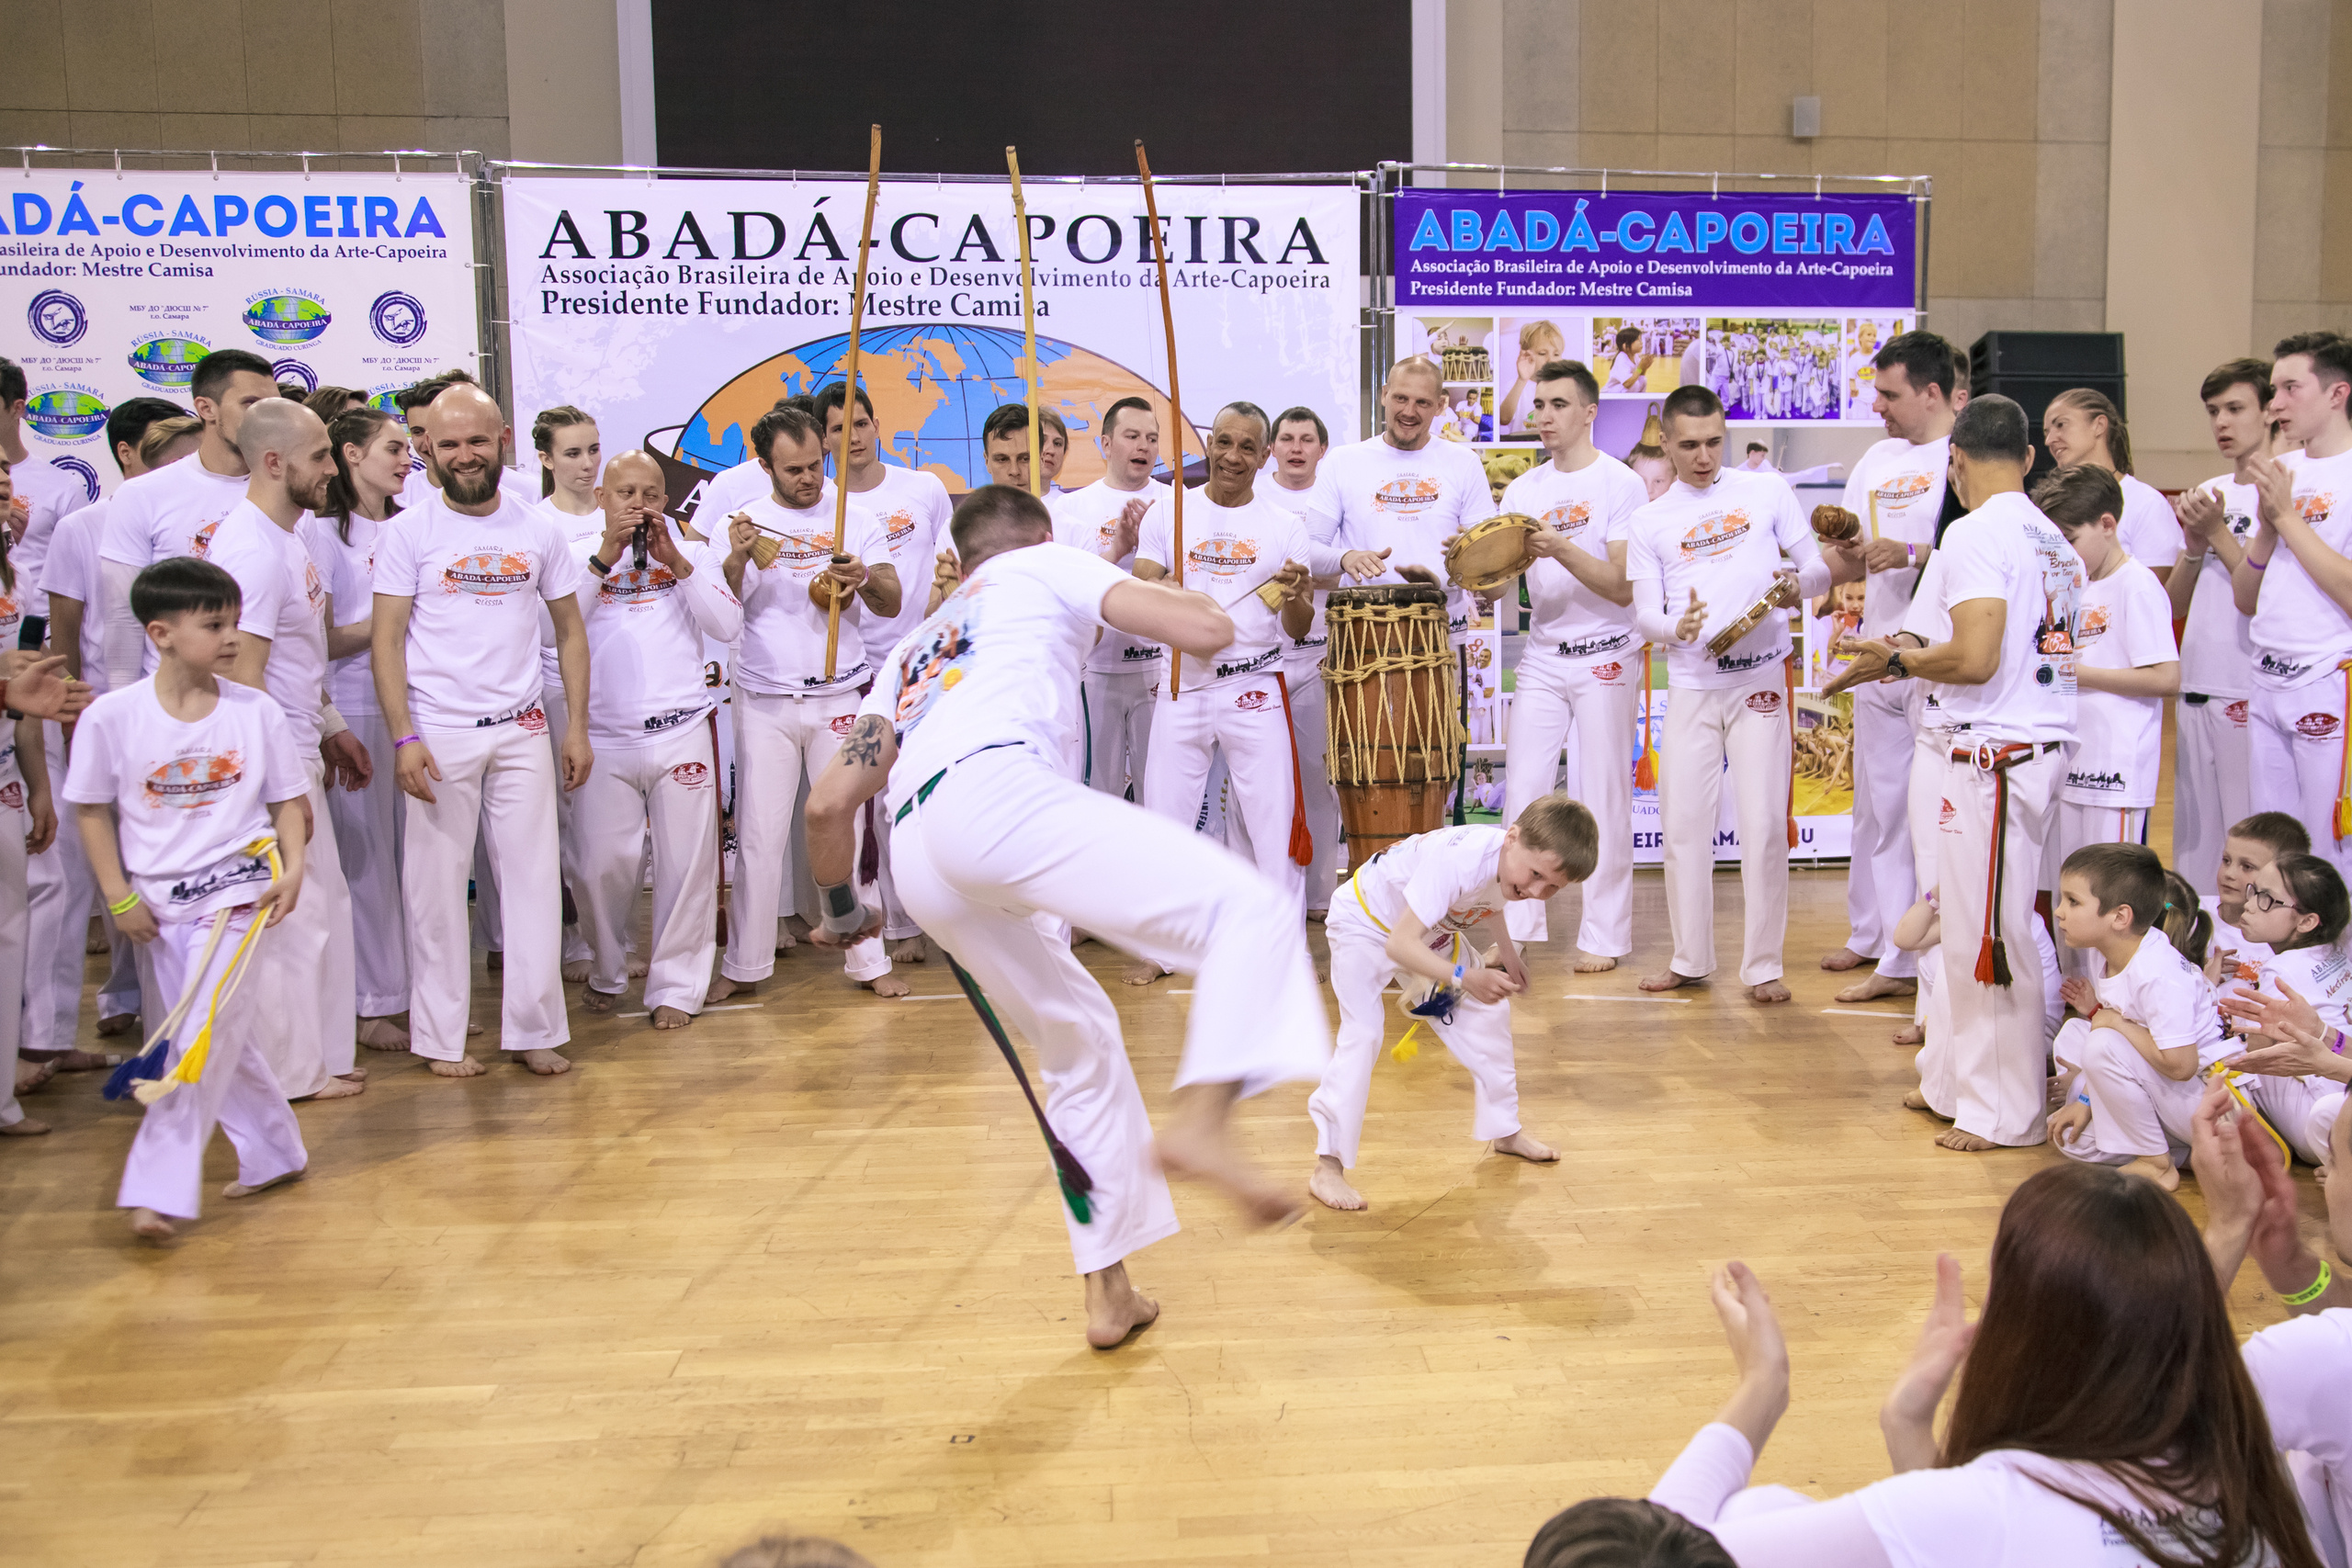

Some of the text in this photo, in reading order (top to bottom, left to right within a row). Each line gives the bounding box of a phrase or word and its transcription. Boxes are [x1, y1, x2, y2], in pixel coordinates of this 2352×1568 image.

[0, 180, 447, 238] DÁ-CAPOEIRA
[538, 196, 1330, 265] ABADÁ-CAPOEIRA
[1408, 198, 1895, 255] ABADÁ-CAPOEIRA
[65, 243, 85, 256] de
[90, 243, 141, 261] Apoio
[146, 247, 155, 257] e
[159, 243, 305, 258] Desenvolvimento
[310, 244, 329, 258] da
[334, 244, 447, 263] Arte-Capoeira
[82, 262, 143, 276] Mestre
[148, 262, 214, 276] Camisa
[1410, 259, 1894, 279] Associação Brasileira de Apoio e Desenvolvimento da Arte-Capoeira
[541, 264, 670, 289] Associação
[677, 265, 790, 285] Brasileira
[797, 265, 825, 286] de
[910, 273, 922, 286] e
[1172, 268, 1330, 294] Arte-Capoeira
[286, 287, 325, 305] SAMARA
[1410, 281, 1692, 297] Presidente Fundador: Mestre Camisa
[541, 290, 1050, 317] Presidente Fundador: Mestre Camia
[171, 330, 211, 347] SAMARA
[54, 365, 82, 373] Самара
[394, 365, 420, 373] Самара
[63, 381, 105, 400] SAMARA
[368, 382, 396, 397] ÚSSIA
